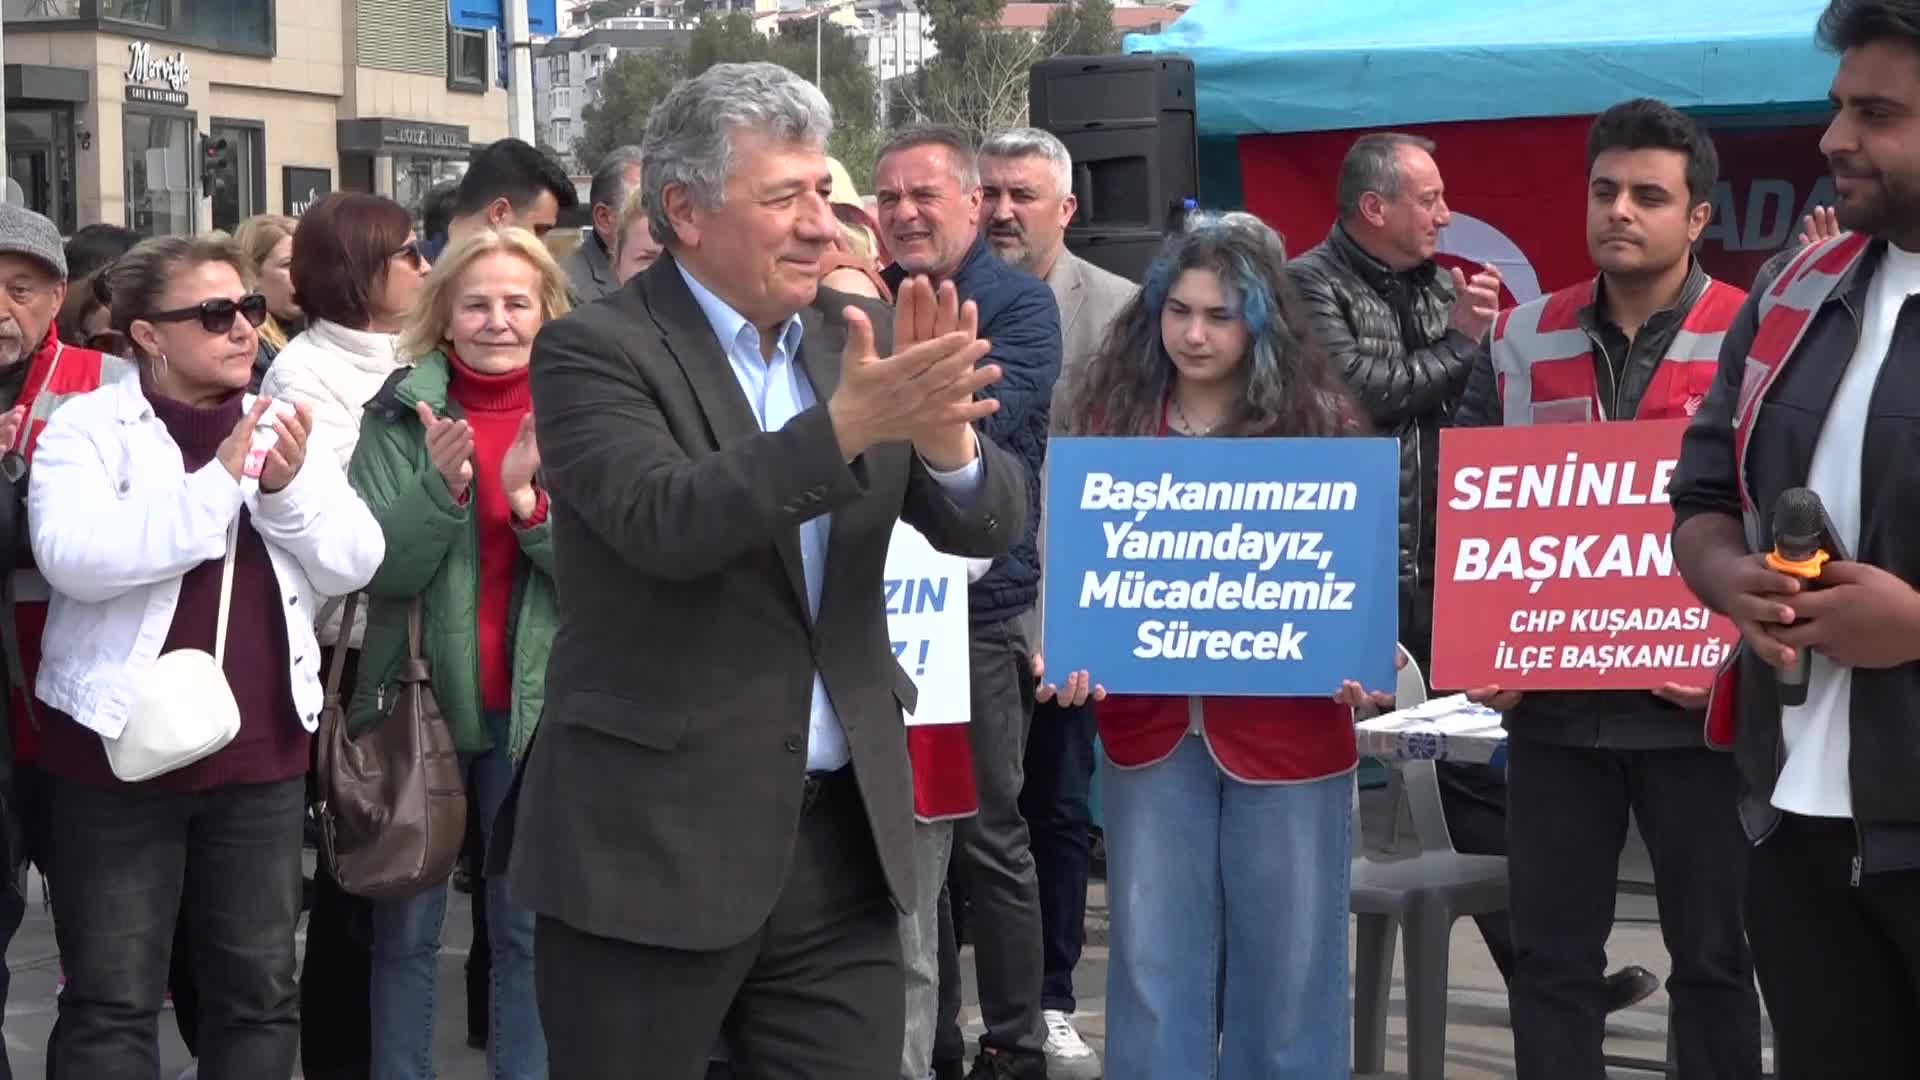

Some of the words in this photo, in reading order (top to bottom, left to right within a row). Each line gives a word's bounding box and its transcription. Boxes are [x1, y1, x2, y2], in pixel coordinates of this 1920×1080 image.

[1080, 472, 1358, 522] Başkanımızın
[1449, 452, 1679, 511] SENİNLE
[1102, 521, 1333, 571] Yanındayız,
[1453, 533, 1681, 594] BAŞKAN
[1079, 571, 1356, 610] Mücadelemiz
[1132, 620, 1308, 660] Sürecek
[1510, 609, 1566, 633] CHP
[1570, 607, 1710, 639] KUŞADASI
[1494, 641, 1556, 676] İLÇE
[1560, 637, 1730, 675] BAŞKANLIĞI
